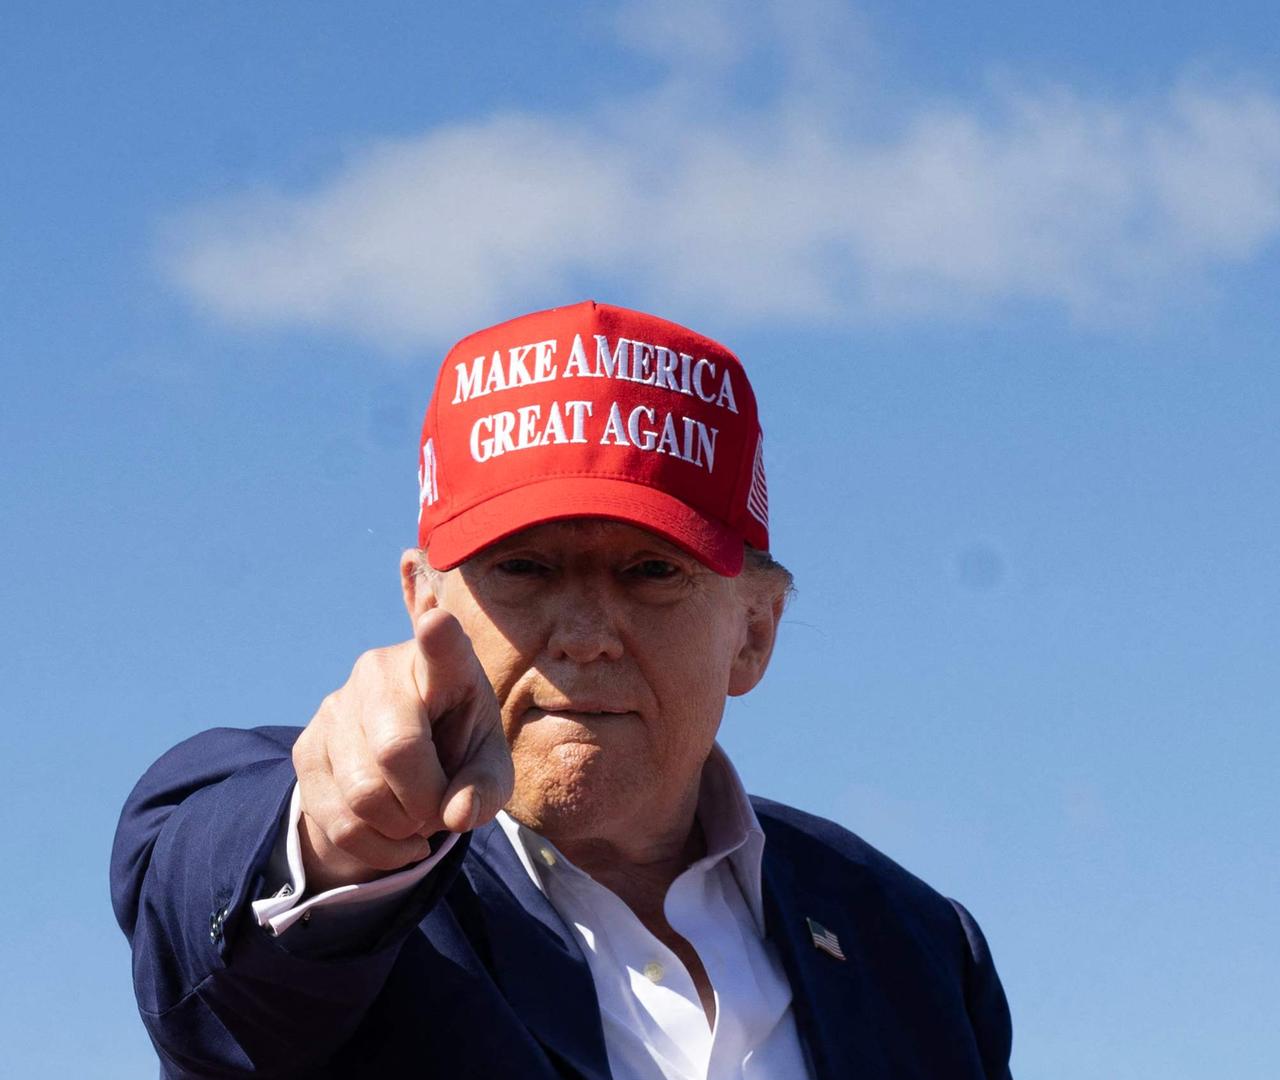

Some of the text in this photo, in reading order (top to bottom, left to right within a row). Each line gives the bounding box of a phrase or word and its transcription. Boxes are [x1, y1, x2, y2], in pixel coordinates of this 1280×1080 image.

[451, 333, 739, 415] MAKE AMERICA
[470, 401, 719, 474] GREAT AGAIN
